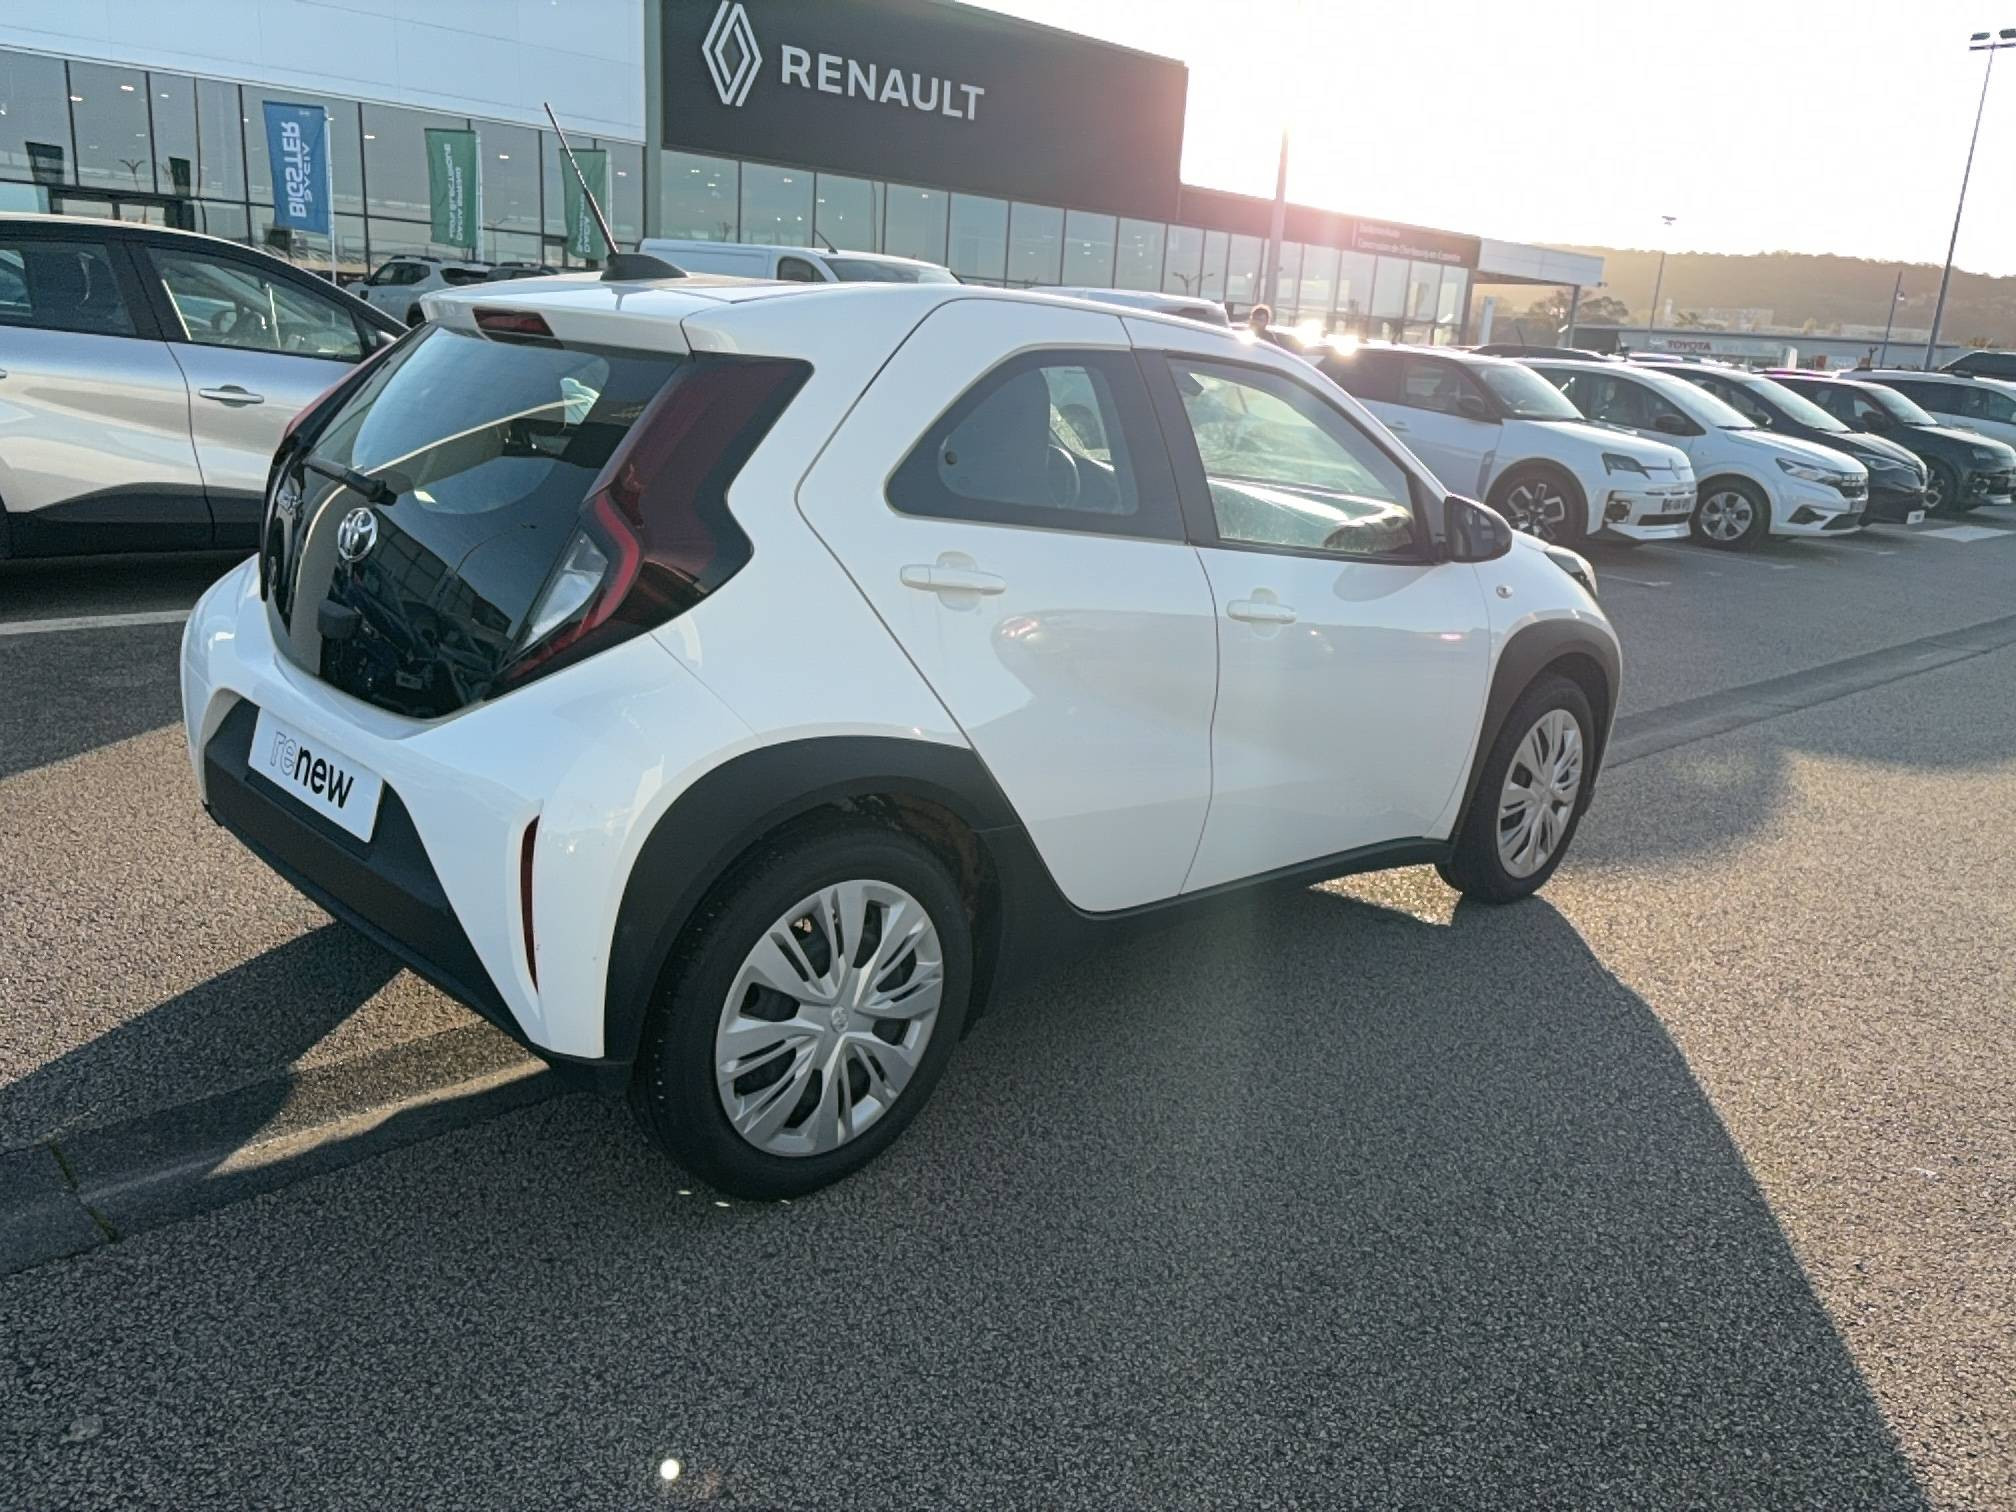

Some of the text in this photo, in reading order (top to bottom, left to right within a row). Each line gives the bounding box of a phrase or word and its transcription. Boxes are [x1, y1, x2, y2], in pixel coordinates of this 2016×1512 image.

[781, 44, 985, 121] RENAULT
[1667, 340, 1711, 351] TOYOTA
[270, 731, 354, 809] renew
